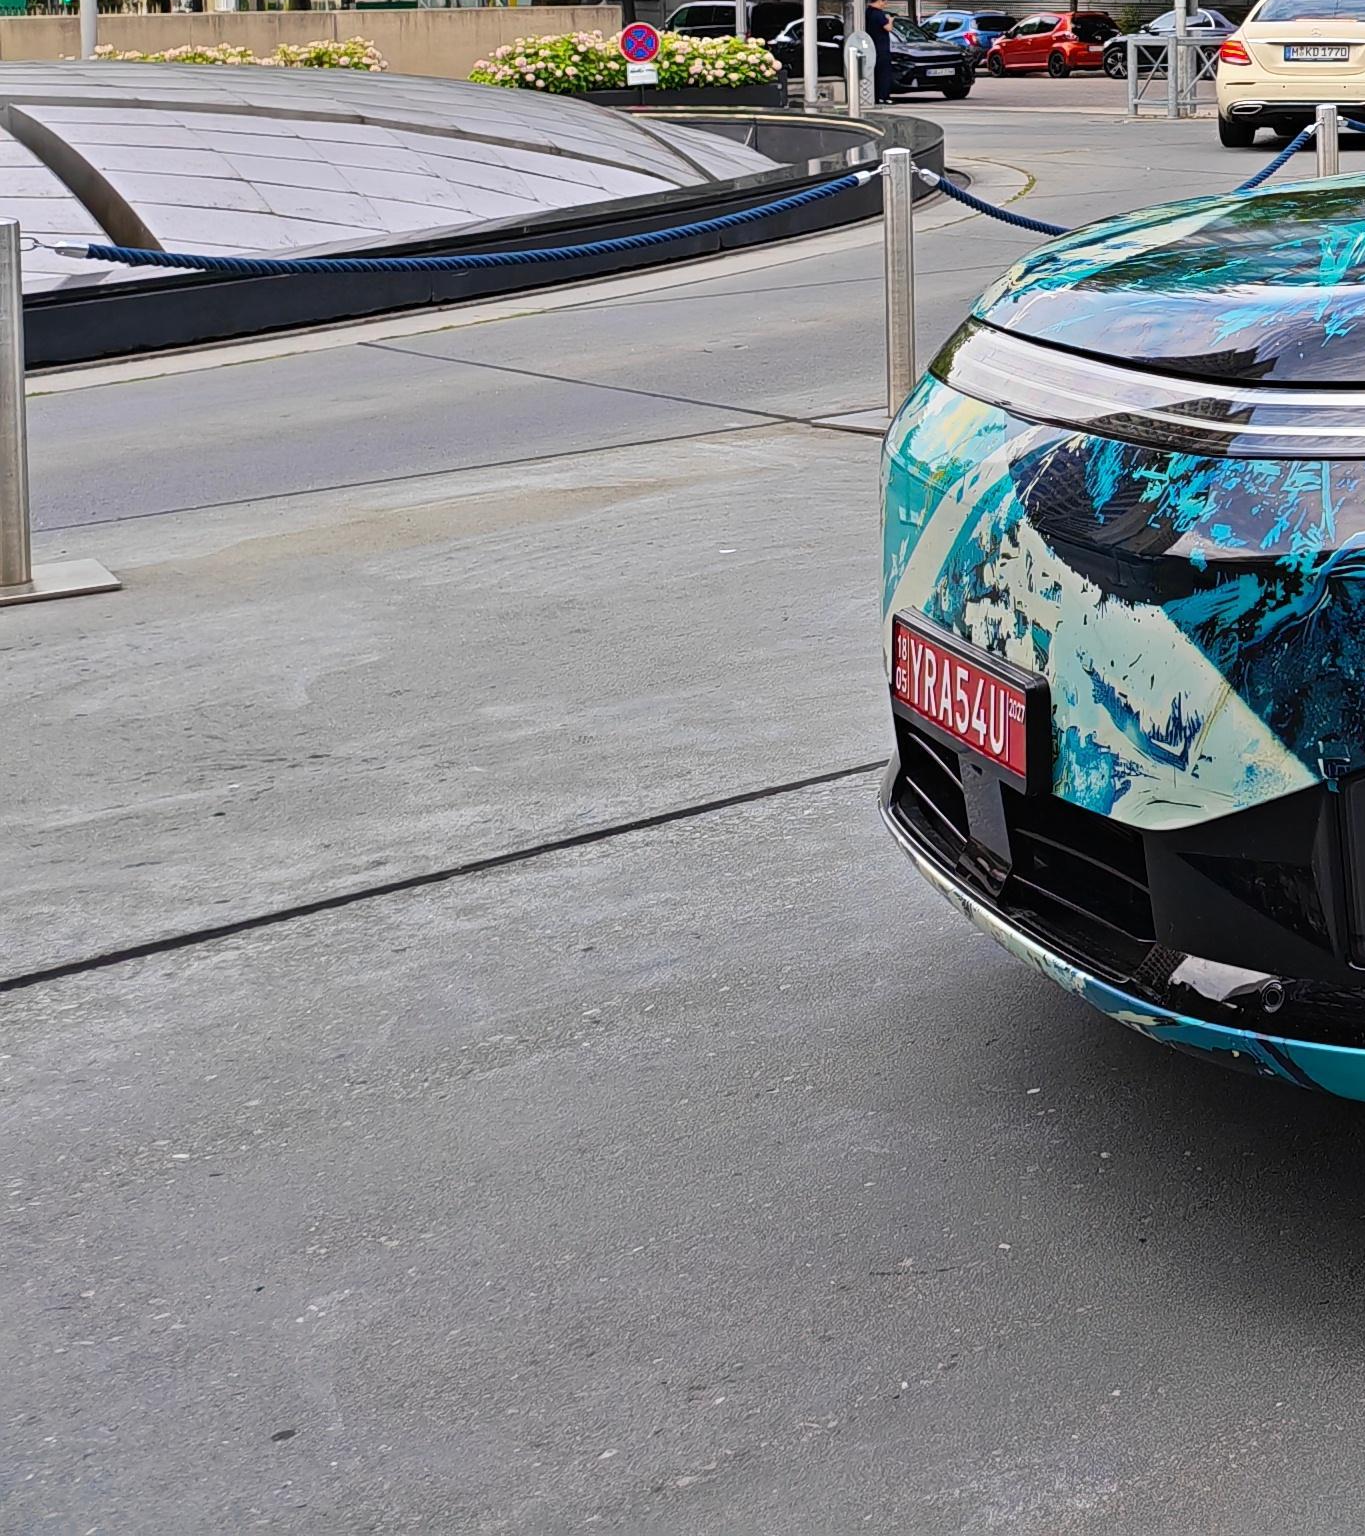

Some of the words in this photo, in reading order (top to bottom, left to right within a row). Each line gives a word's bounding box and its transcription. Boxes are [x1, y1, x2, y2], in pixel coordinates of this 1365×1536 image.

[897, 634, 907, 661] 18
[896, 666, 907, 693] 05
[911, 638, 1005, 755] YRA54U
